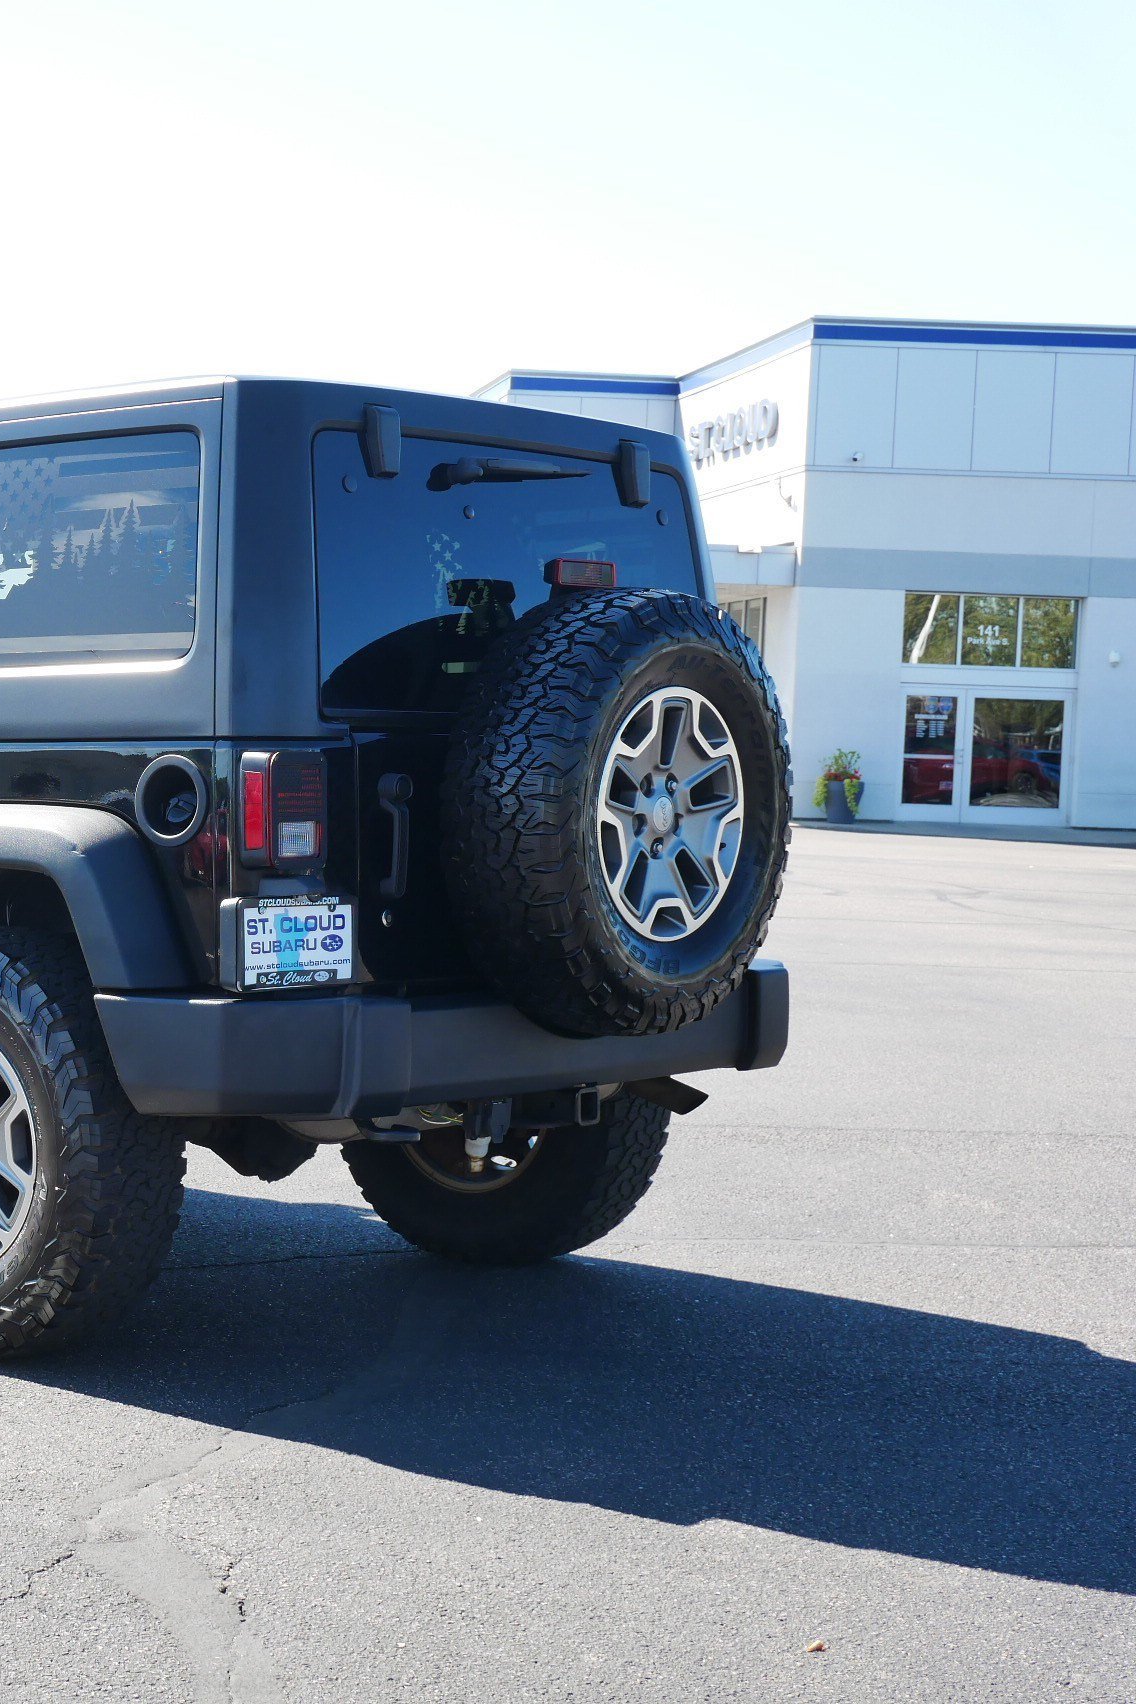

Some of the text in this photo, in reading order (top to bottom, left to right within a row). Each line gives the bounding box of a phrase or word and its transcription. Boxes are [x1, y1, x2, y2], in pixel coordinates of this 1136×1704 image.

[714, 398, 779, 453] CLOUD
[977, 624, 1000, 637] 141
[967, 637, 984, 645] Park
[986, 637, 1001, 646] Ave
[259, 897, 339, 906] STCLOUDSUBA.COM
[246, 913, 346, 936] ST. CLOUD
[250, 938, 317, 955] SUBARU
[245, 958, 351, 972] www.stcloudsubaru.com
[265, 971, 314, 986] St. Cloud
